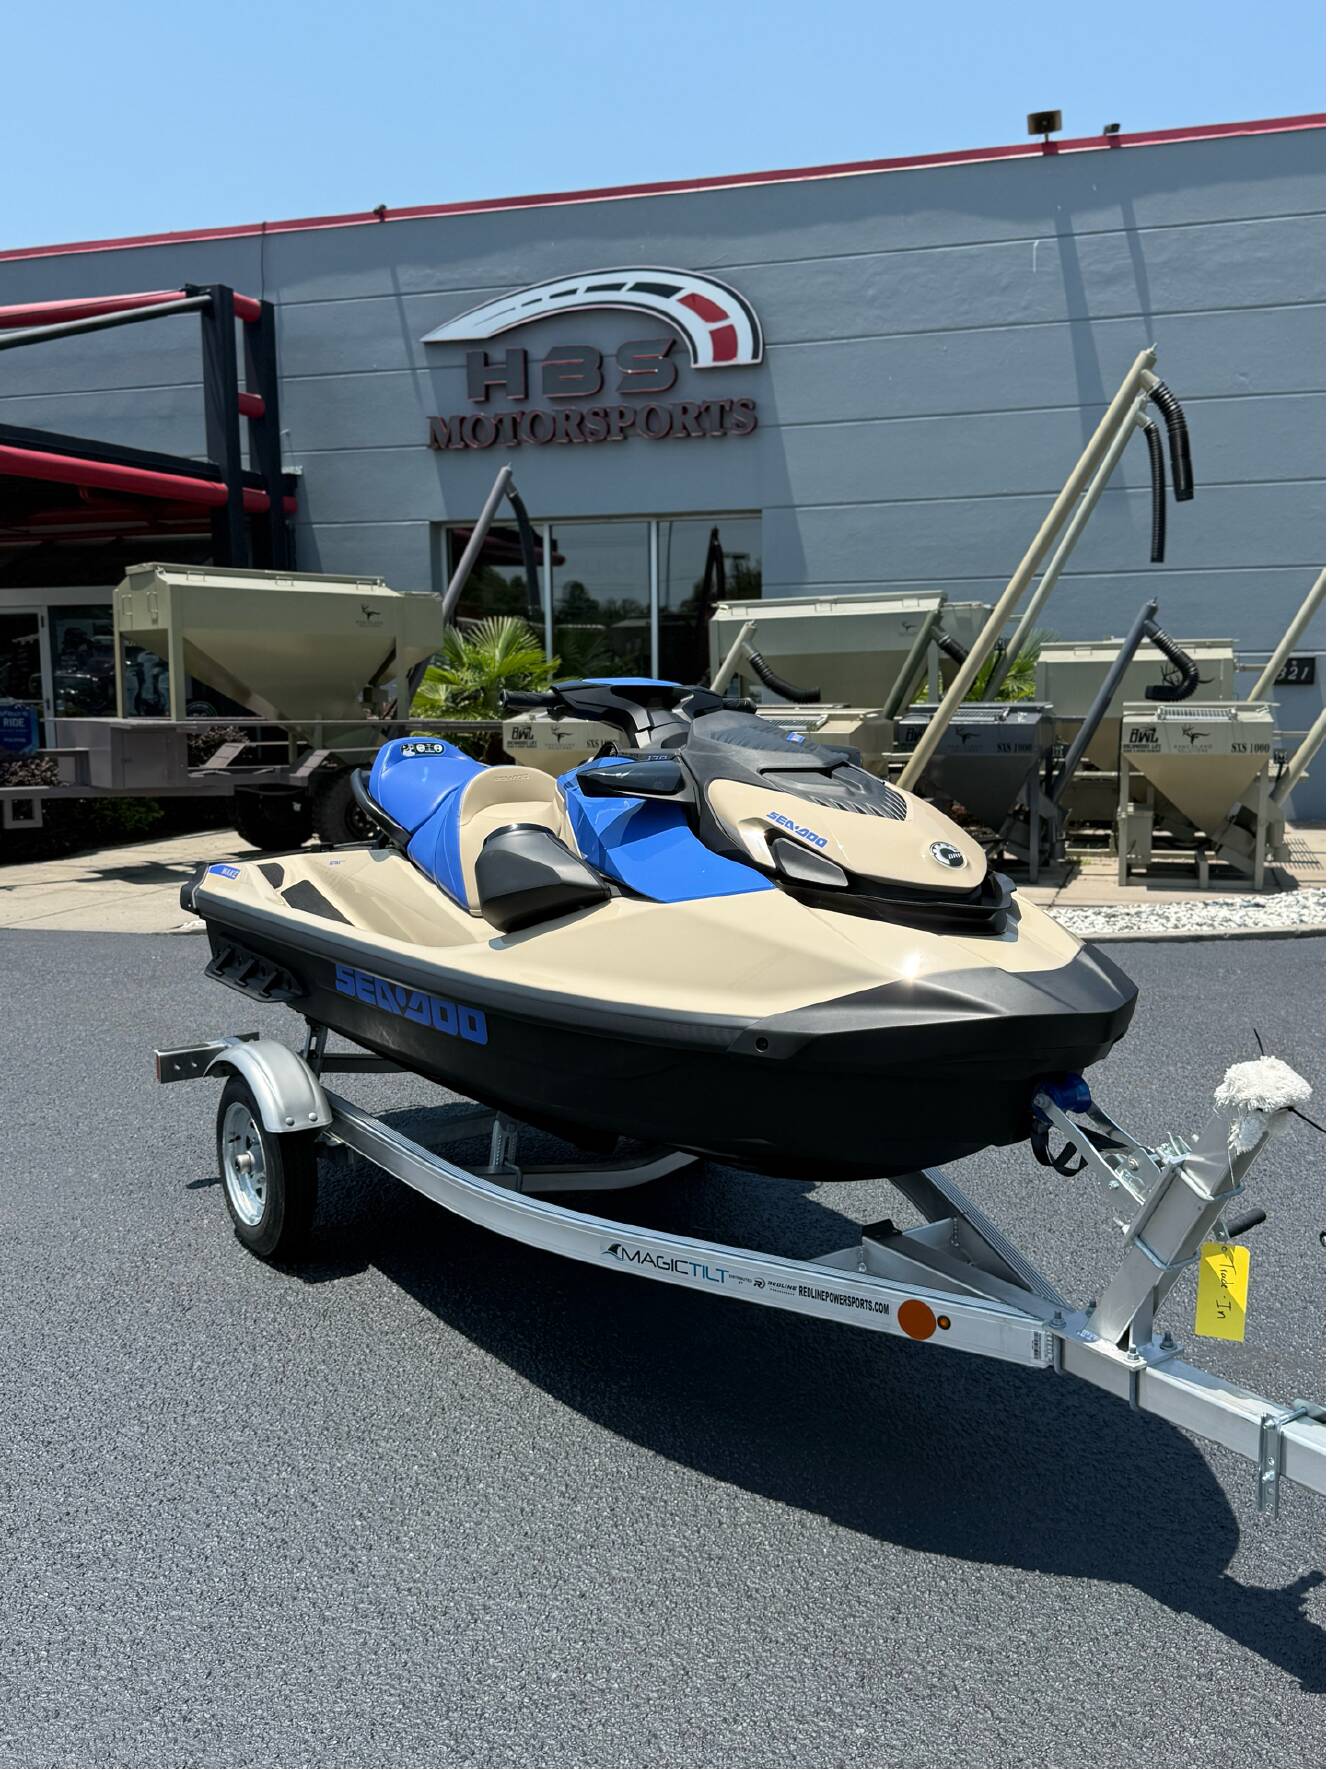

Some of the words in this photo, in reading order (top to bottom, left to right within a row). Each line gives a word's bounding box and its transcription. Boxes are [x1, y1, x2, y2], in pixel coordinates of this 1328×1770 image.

[466, 337, 678, 403] HBS
[426, 398, 757, 450] MOTORSPORTS
[1231, 743, 1247, 753] SXS
[1250, 743, 1270, 753] 1000
[621, 1247, 729, 1284] MAGICTILT
[798, 1285, 890, 1315] REDLINEPOWERSPORTS.COM
